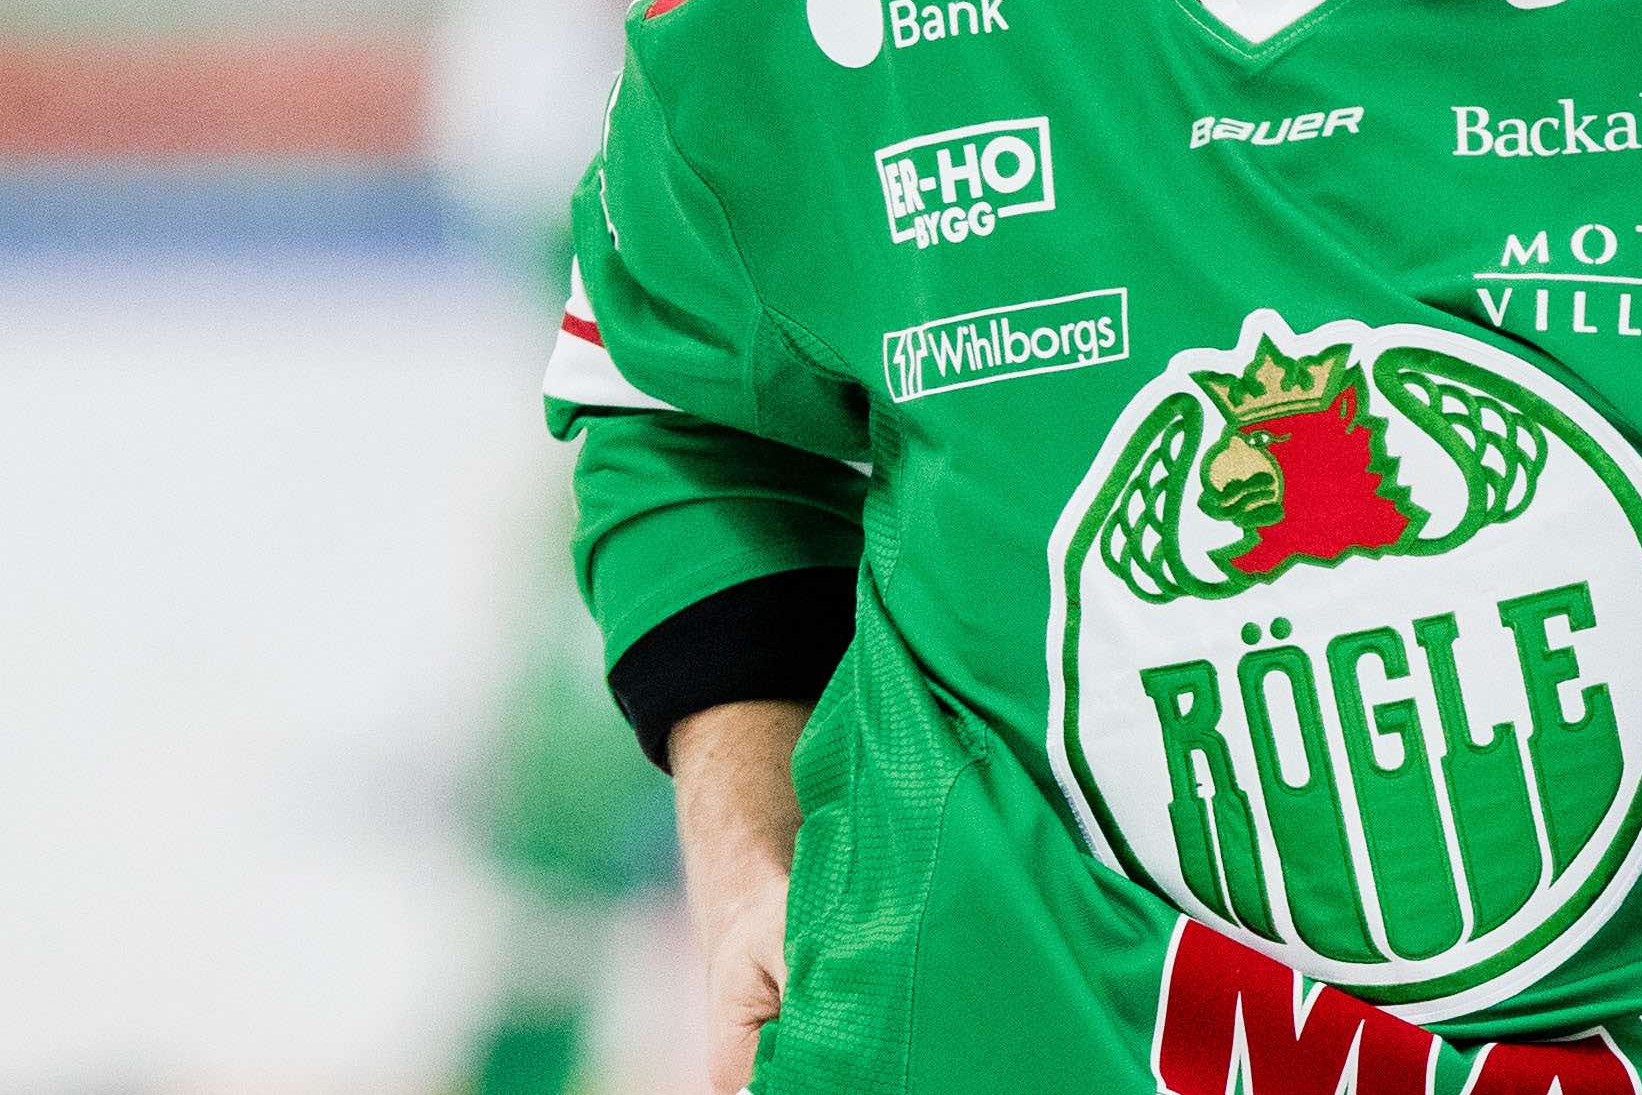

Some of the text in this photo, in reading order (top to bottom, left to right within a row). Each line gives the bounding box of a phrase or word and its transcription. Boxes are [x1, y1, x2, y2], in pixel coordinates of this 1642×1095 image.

[885, 135, 1036, 218] ER-HO
[914, 201, 996, 250] BYGG
[927, 316, 1117, 377] Wihlborgs
[1139, 580, 1625, 963] RÖGLE
